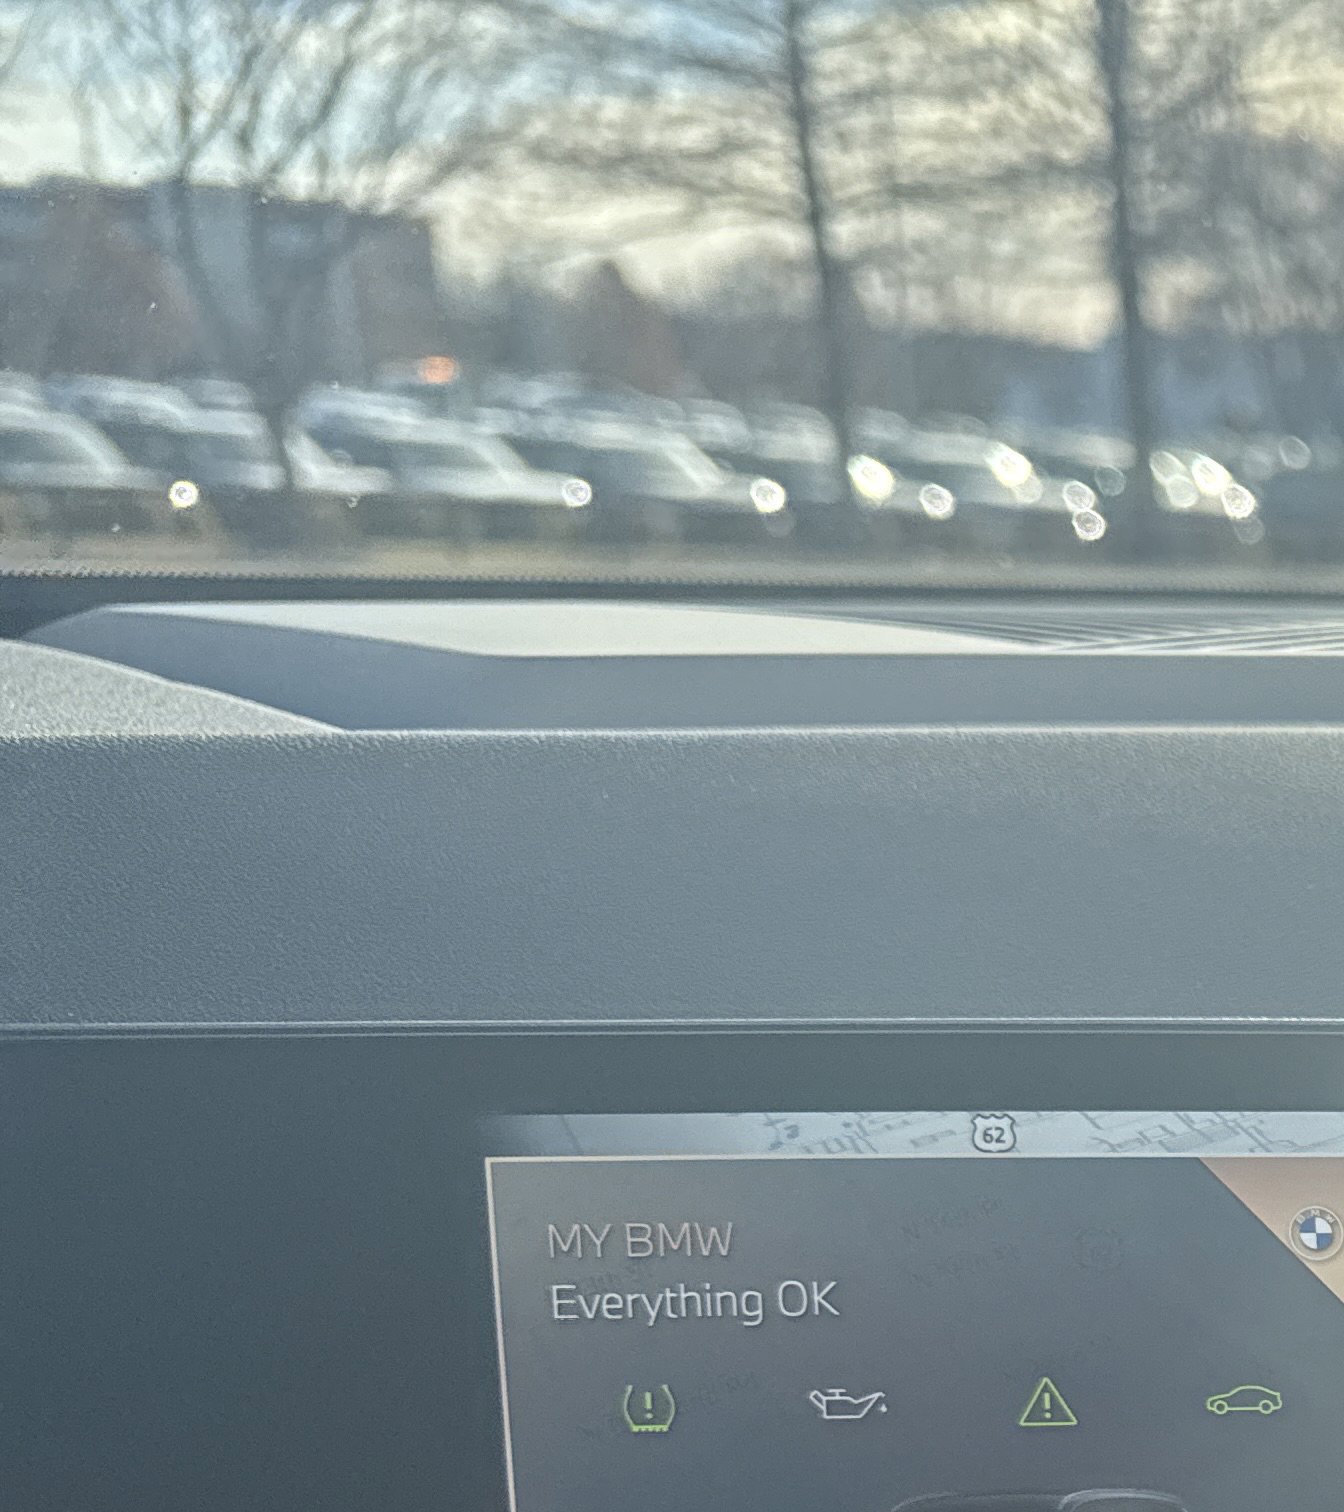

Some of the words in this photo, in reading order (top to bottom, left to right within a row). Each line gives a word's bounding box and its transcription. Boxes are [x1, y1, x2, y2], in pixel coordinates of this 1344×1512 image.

[981, 1125, 1007, 1147] 62
[546, 1221, 612, 1259] MY
[625, 1221, 734, 1258] BMW
[550, 1283, 766, 1328] Everything
[776, 1279, 841, 1319] OK
